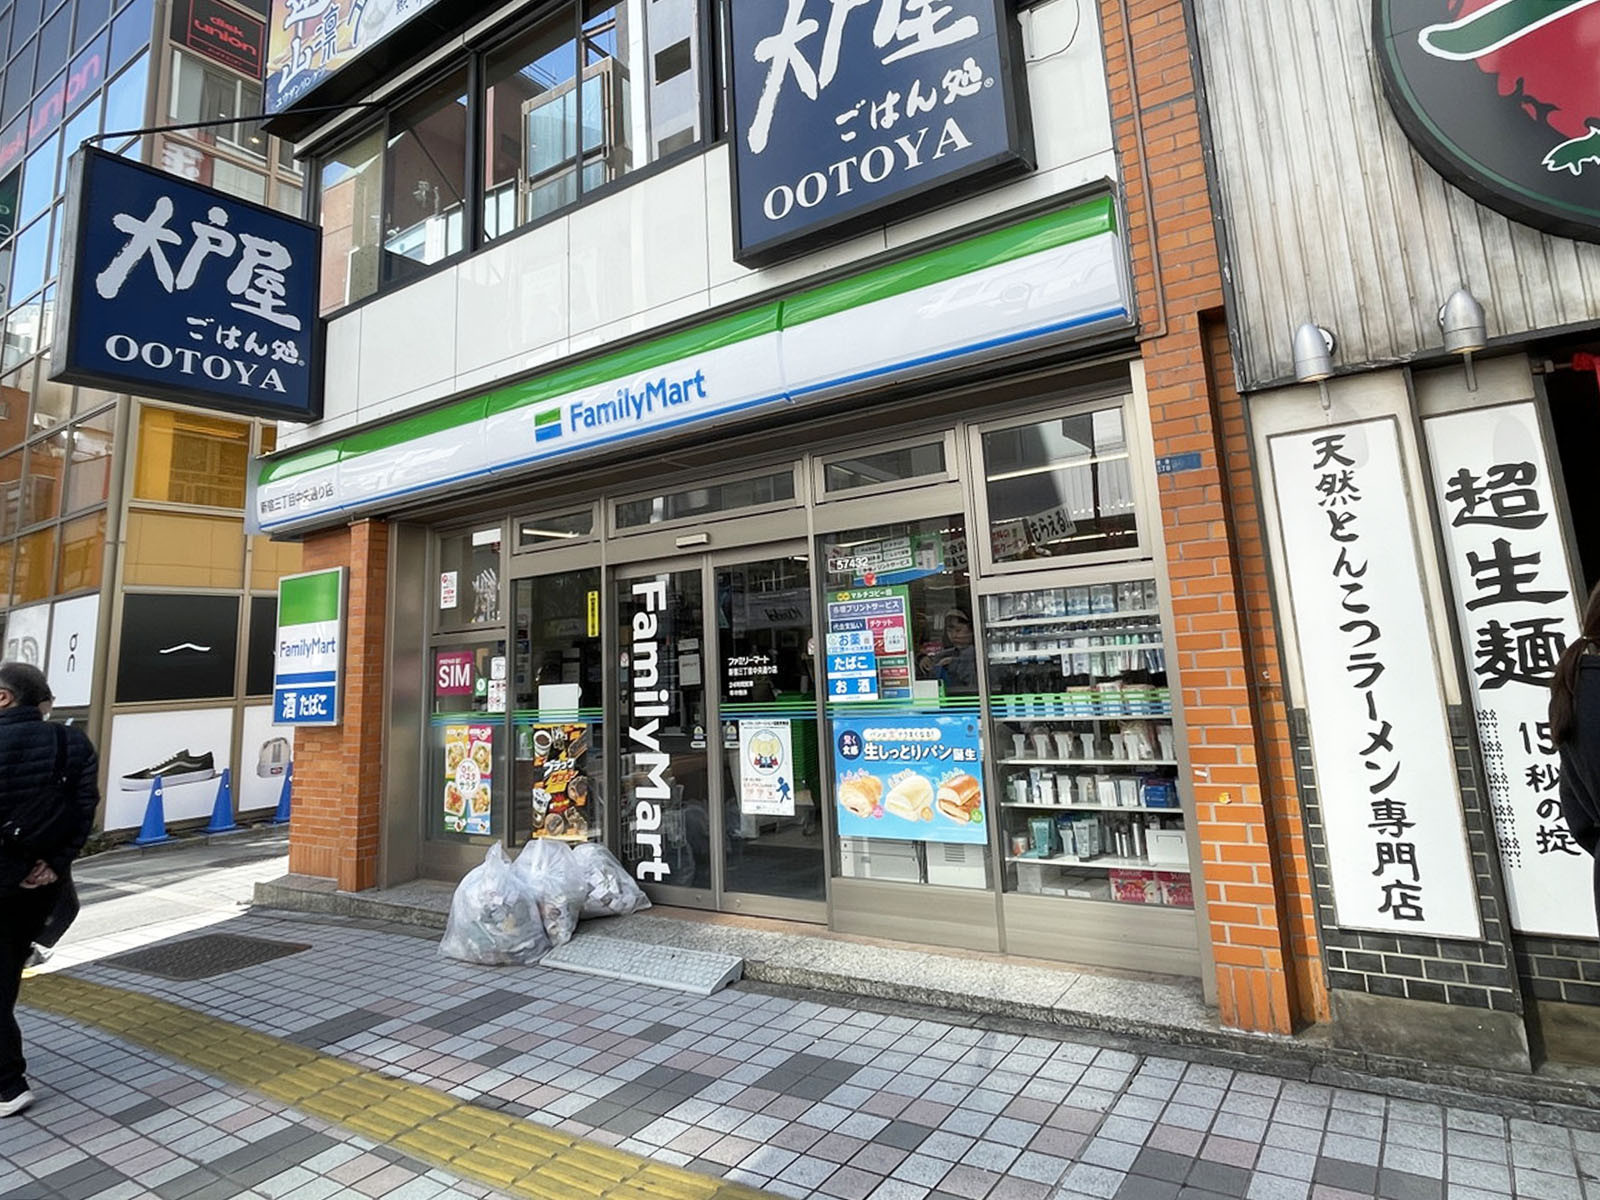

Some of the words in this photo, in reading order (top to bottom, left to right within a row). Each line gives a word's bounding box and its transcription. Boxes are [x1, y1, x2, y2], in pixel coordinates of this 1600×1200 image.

[194, 19, 257, 57] union
[210, 16, 244, 38] disk
[835, 57, 983, 142] ごはん処
[763, 117, 974, 221] OOTOYA
[96, 196, 301, 331] 大戸屋
[105, 333, 287, 393] OOTOYA
[186, 316, 300, 366] ごはん処
[569, 369, 706, 432] FamilyMart
[1445, 461, 1569, 690] 超生麺
[280, 637, 336, 658] FamilyMart
[728, 655, 770, 666] ファミリーマート
[834, 656, 868, 671] たばこ
[438, 663, 471, 688] SIM
[1312, 433, 1425, 922] 天然とんこつラーメン専門店
[282, 692, 297, 719] 酒
[299, 693, 328, 716] たばこ
[628, 580, 672, 883] FamilyMart
[864, 743, 978, 762] 生しっとりパン誕生
